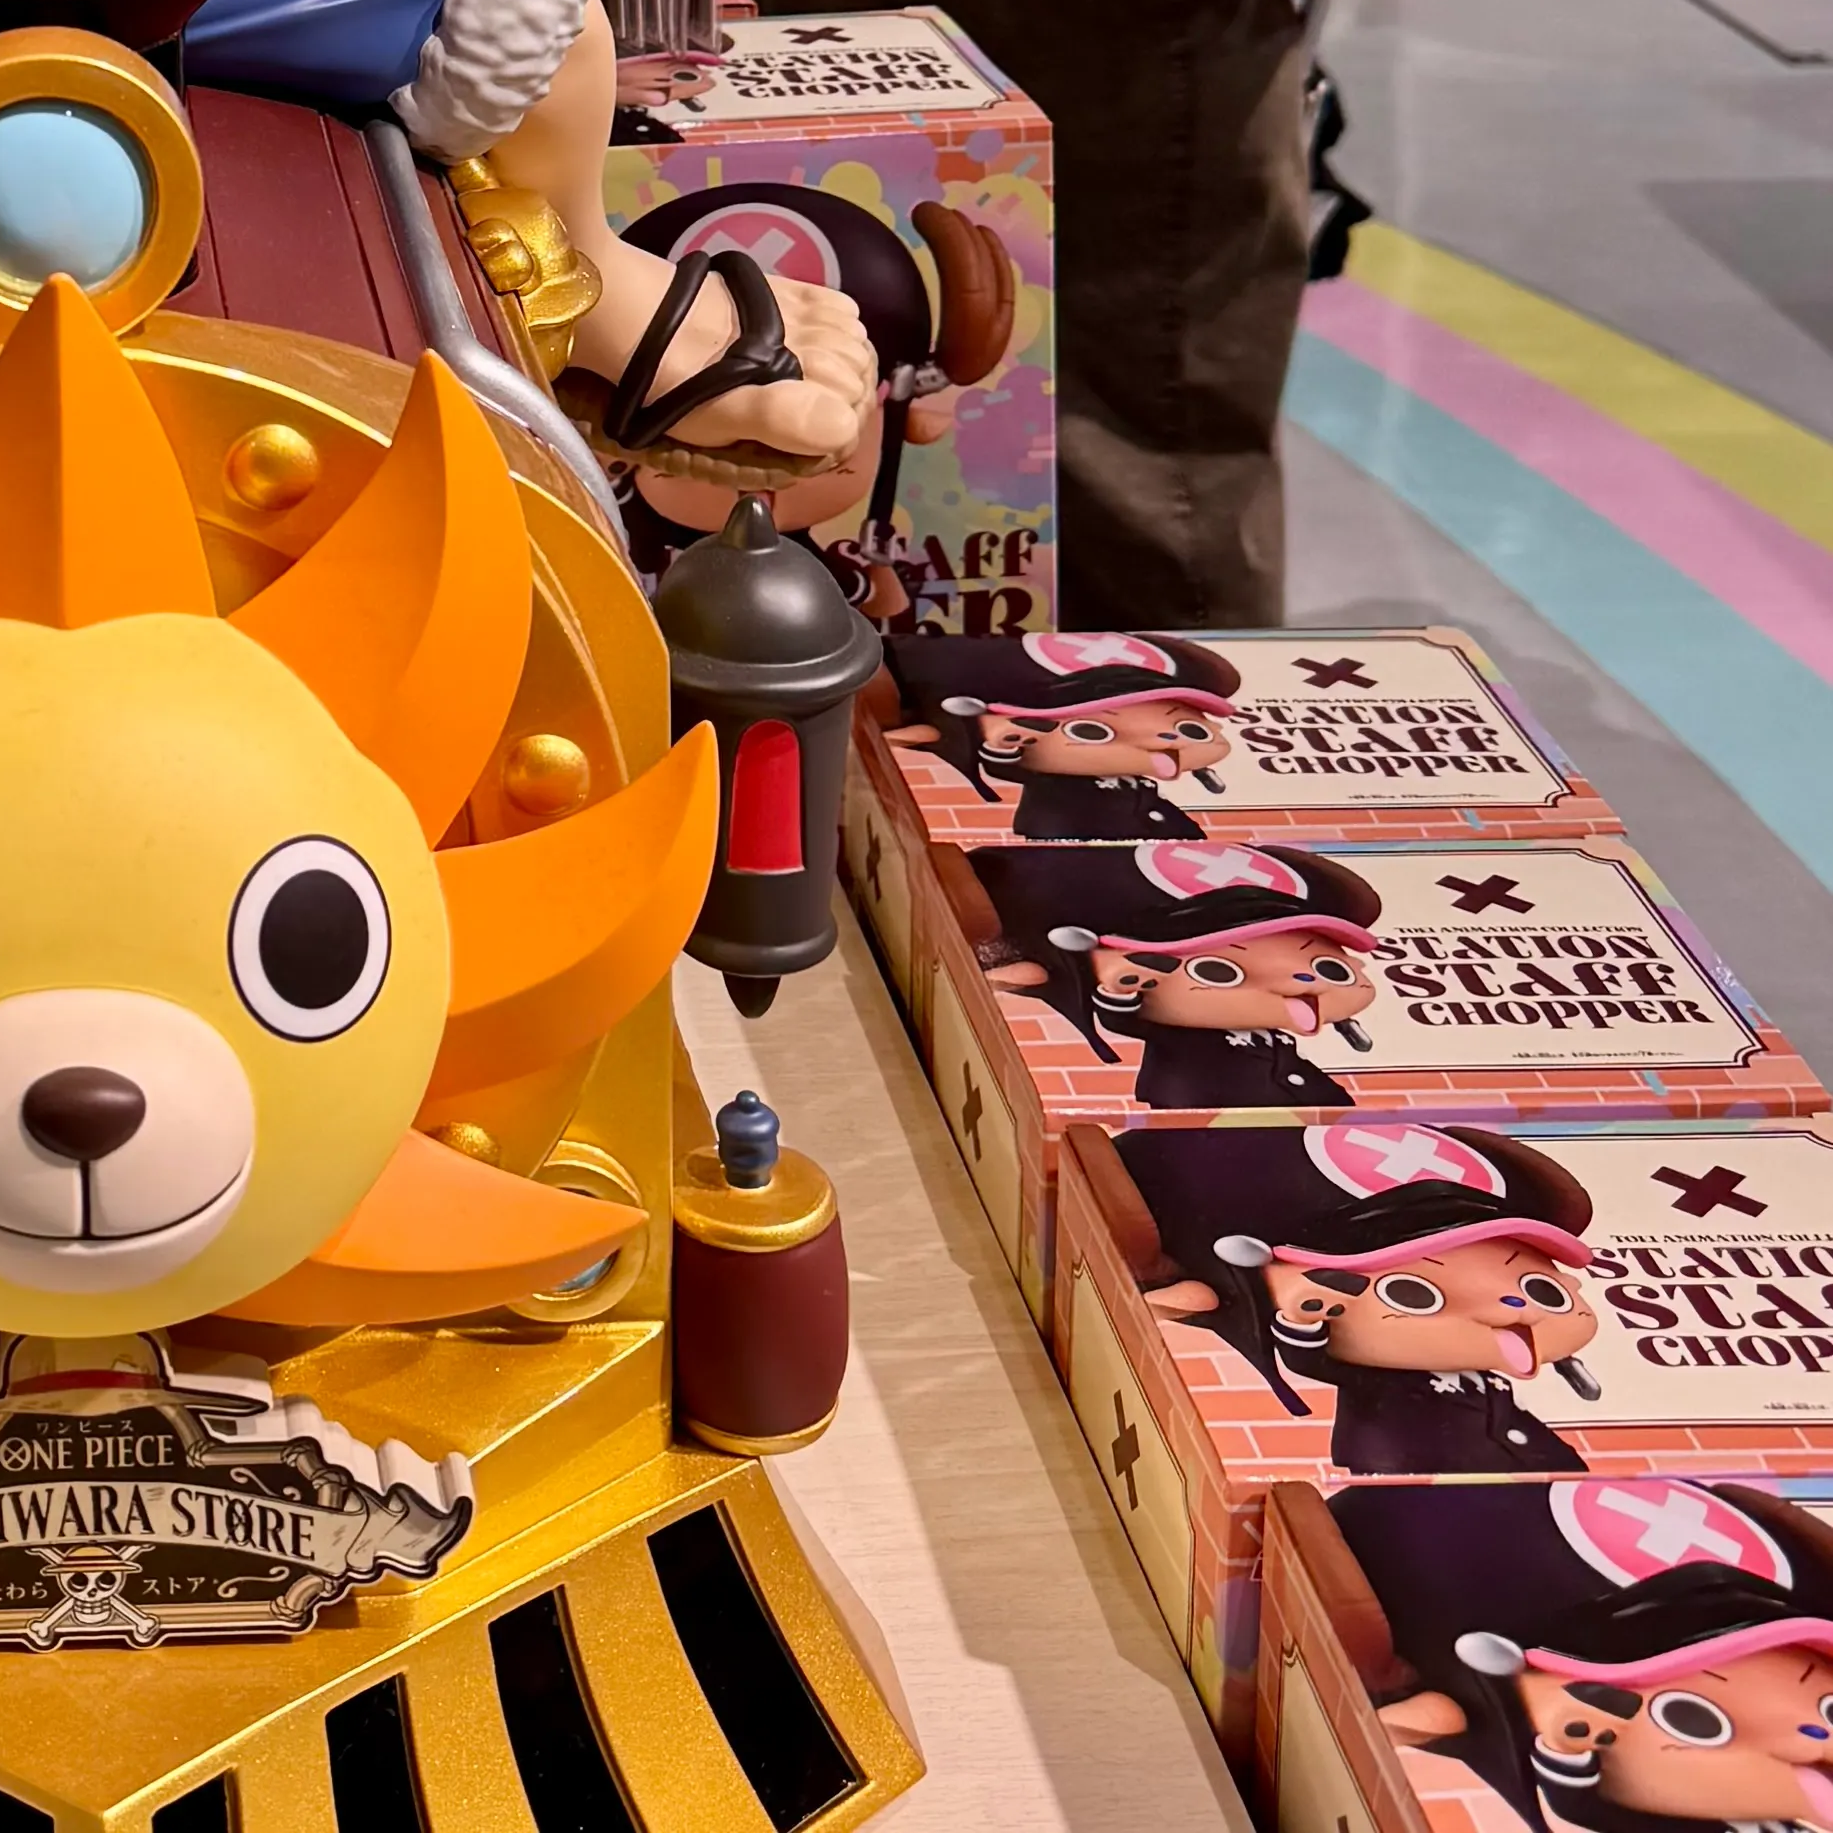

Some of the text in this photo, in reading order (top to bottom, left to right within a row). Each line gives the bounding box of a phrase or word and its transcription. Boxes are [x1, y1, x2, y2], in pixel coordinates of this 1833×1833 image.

[721, 50, 942, 69] STATION
[726, 63, 952, 87] STAFF
[738, 79, 972, 99] CHOPPER
[1230, 705, 1488, 725] STATION
[1240, 726, 1500, 754] STAFF
[1258, 755, 1531, 778] CHOPPER
[1371, 935, 1664, 961] STATION
[1384, 962, 1677, 999] STAFF
[1407, 999, 1715, 1029] CHOPPER
[1663, 1234, 1774, 1243] ANIMATION
[1604, 1283, 1833, 1330] STA
[36, 1419, 134, 1435] ワンピース
[84, 1434, 175, 1469] PIECE
[171, 1486, 316, 1561] STORE
[142, 1576, 206, 1596] ストア
